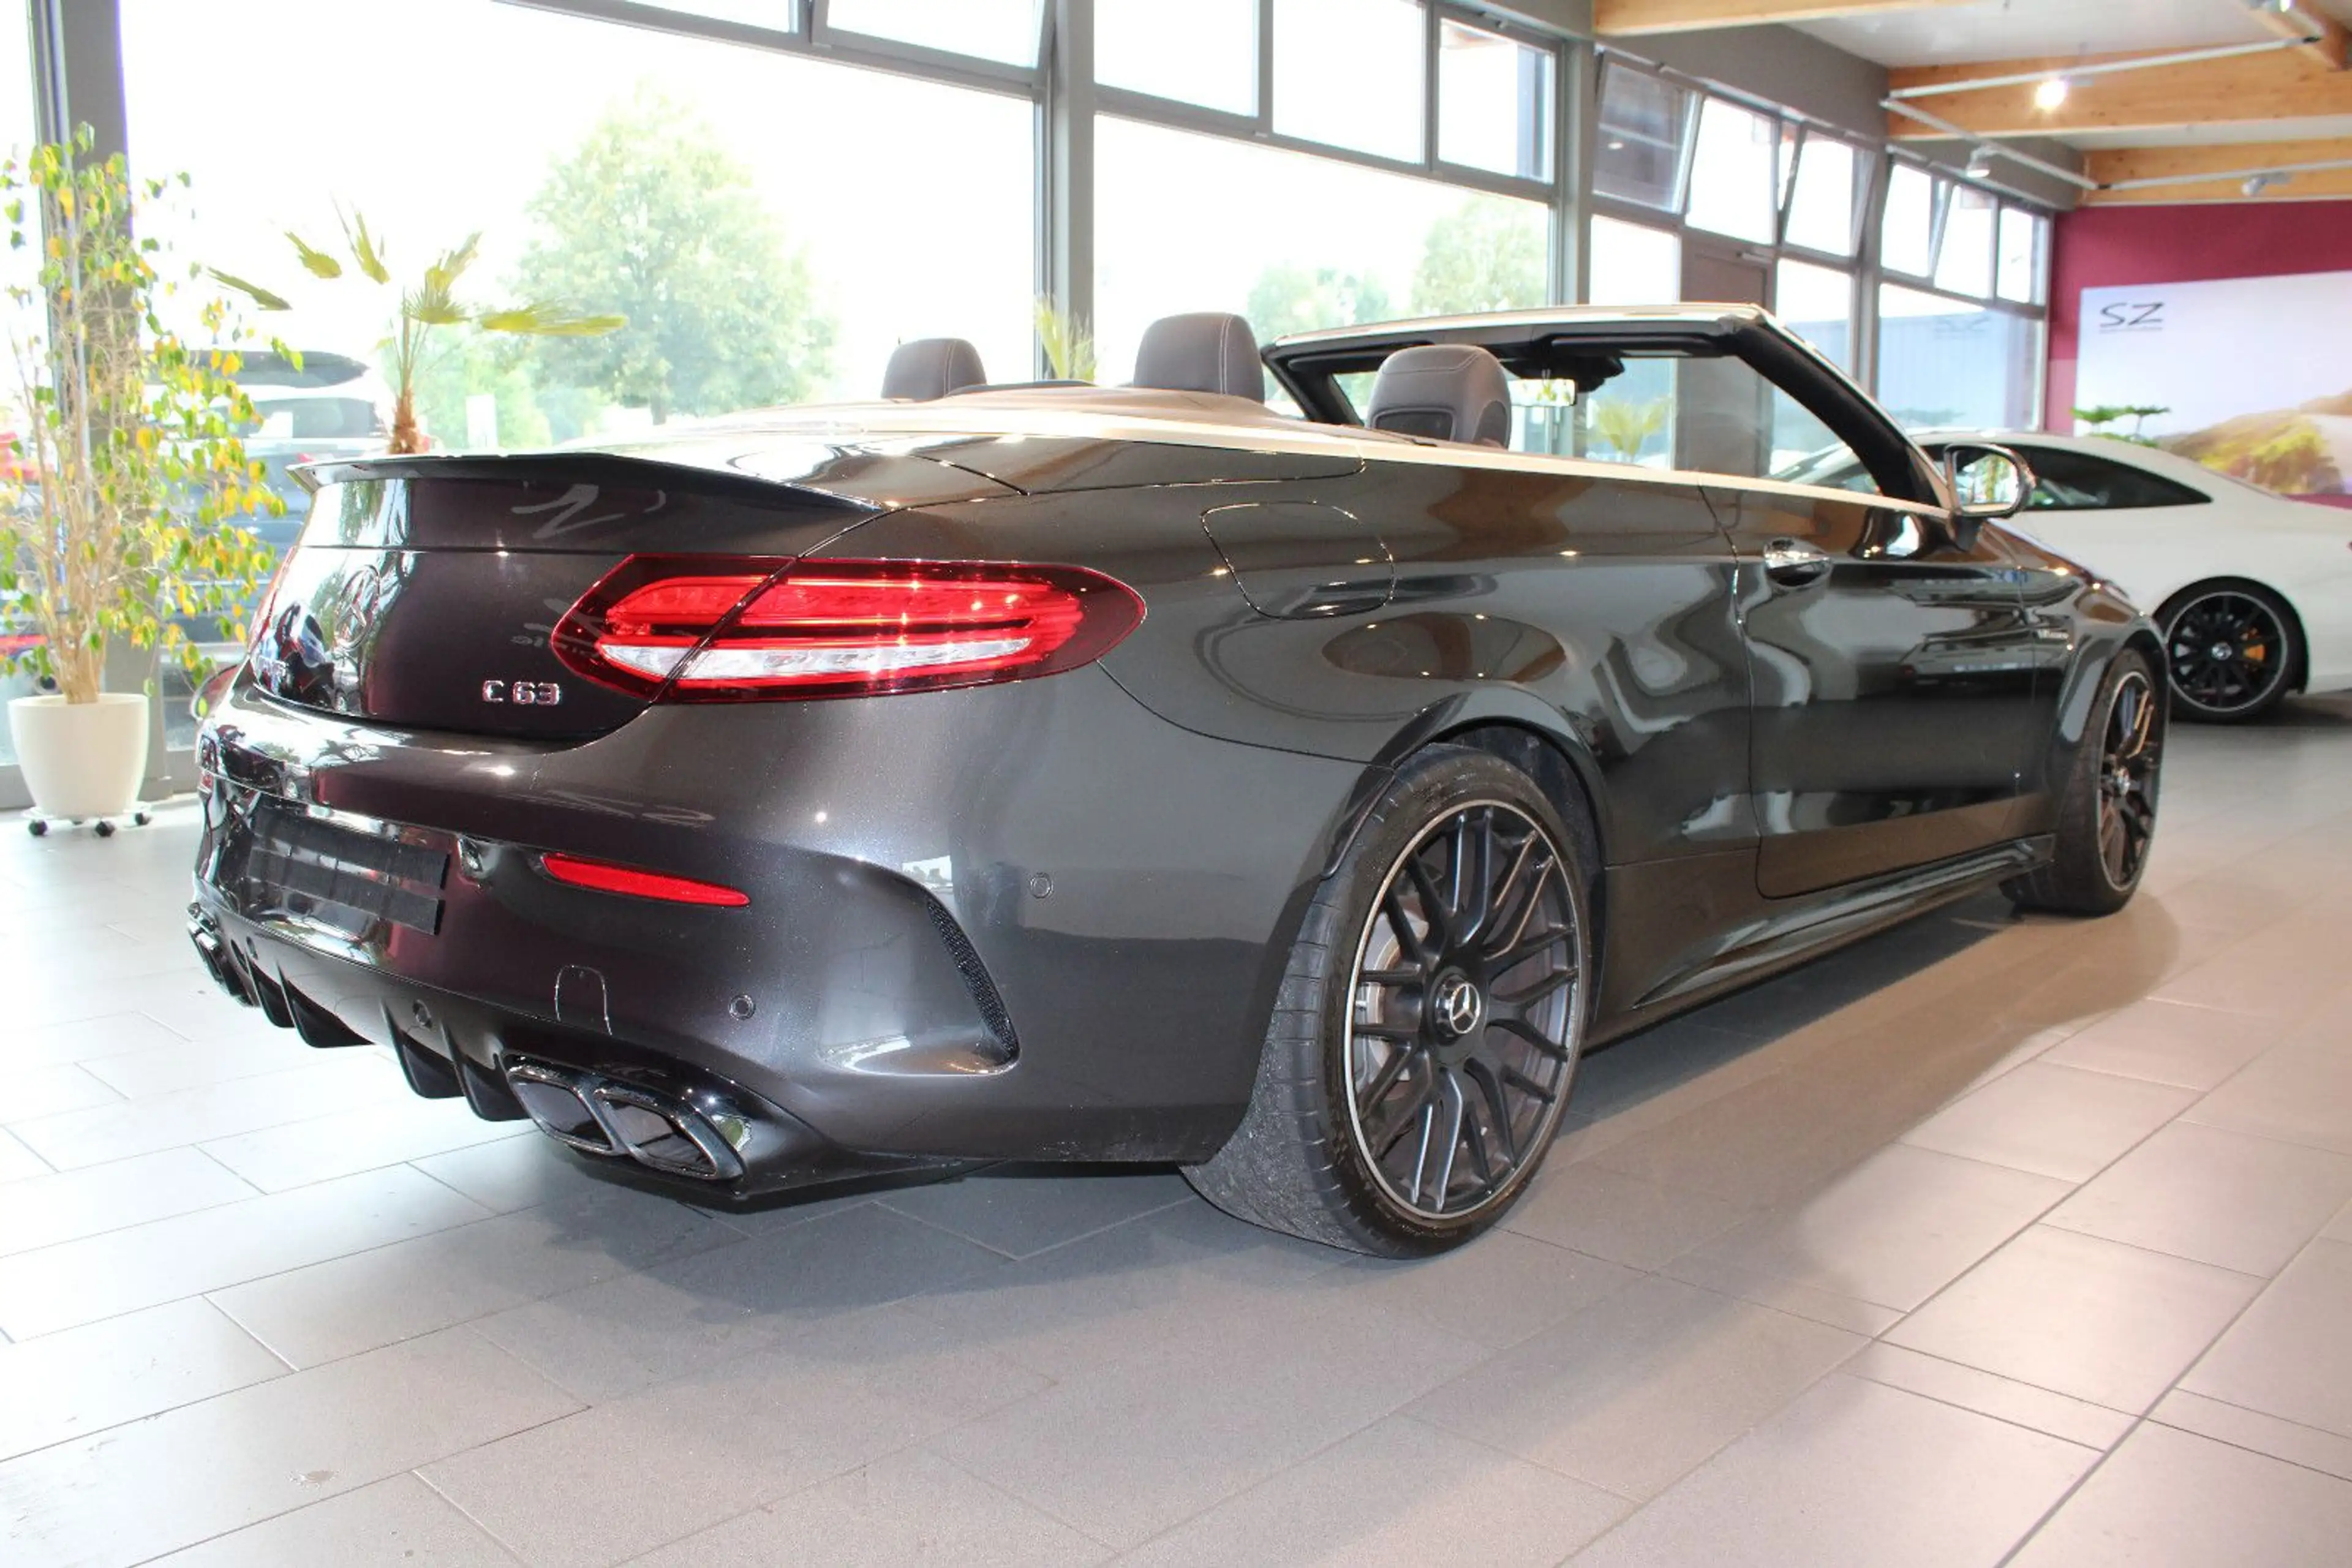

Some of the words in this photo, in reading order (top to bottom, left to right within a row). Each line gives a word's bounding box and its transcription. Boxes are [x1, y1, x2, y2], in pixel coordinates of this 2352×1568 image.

[2100, 301, 2164, 328] SZ
[482, 680, 504, 703] C
[513, 681, 560, 706] 63
